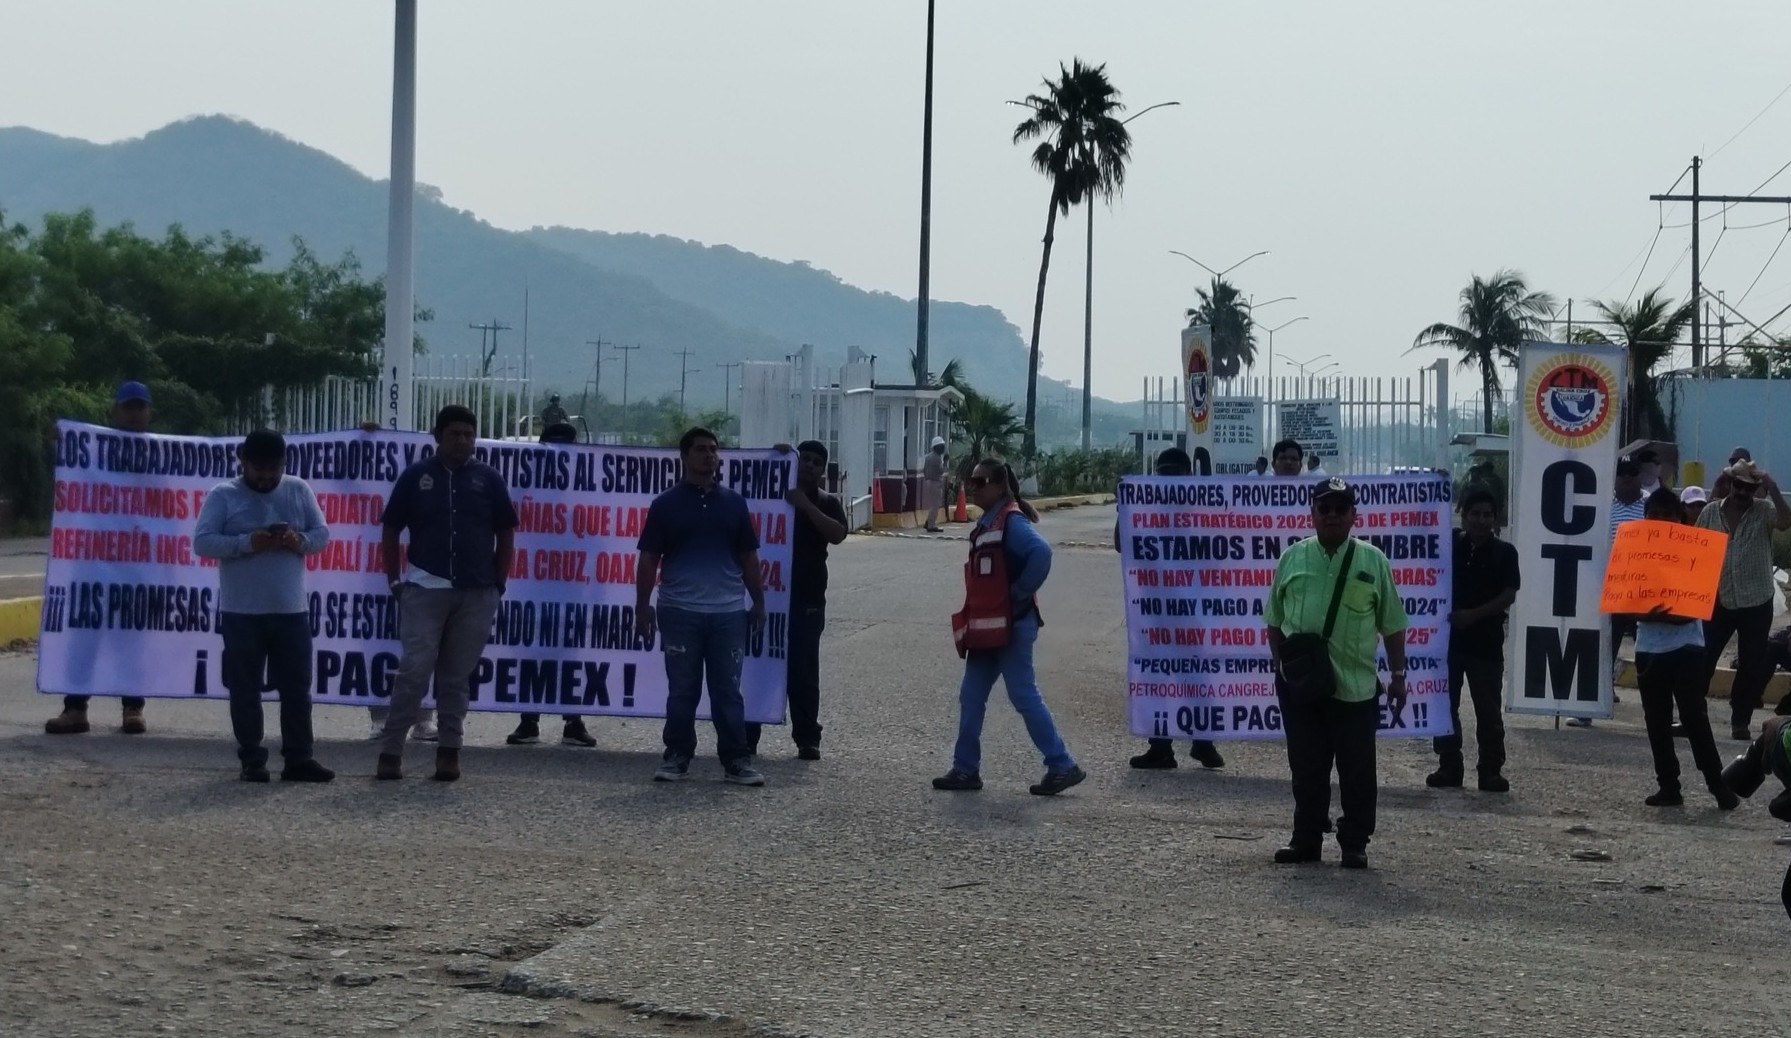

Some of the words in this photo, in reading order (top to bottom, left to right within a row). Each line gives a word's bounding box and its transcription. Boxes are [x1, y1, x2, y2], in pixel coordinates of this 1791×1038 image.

[285, 440, 398, 482] OVEEDORES
[573, 452, 596, 492] AL
[602, 453, 688, 495] SERVICI
[730, 459, 791, 500] PEMEX
[1118, 483, 1229, 510] TRABAJADORES,
[1352, 480, 1451, 507] CONTRATISTAS
[55, 481, 189, 521] SOLICITAMOS
[573, 504, 610, 539] QUE
[766, 513, 787, 545] LA
[1132, 513, 1170, 529] PLAN
[1173, 512, 1273, 529] ESTRATÉGICO
[1368, 513, 1387, 527] DE
[1391, 511, 1440, 527] PEMEX
[1132, 534, 1246, 561] ESTAMOS
[1251, 536, 1281, 560] EN
[1648, 528, 1660, 543] ya
[1668, 525, 1709, 547] basta
[53, 524, 151, 563] REFINERÍA
[156, 534, 194, 567] ING.
[305, 534, 362, 573] OVALÍ
[534, 549, 590, 587] CRUZ,
[1627, 552, 1681, 565] promesas
[1162, 568, 1194, 587] HAY
[1639, 585, 1656, 600] las
[69, 581, 104, 630] LAS
[108, 583, 212, 633] PROMESAS
[326, 591, 348, 639] SE
[540, 602, 560, 648] NI
[564, 603, 587, 648] EN
[1166, 597, 1198, 616] HAY
[1202, 597, 1248, 616] PAGO
[1175, 627, 1207, 646] HAY
[1210, 627, 1256, 647] PAGO
[469, 657, 611, 706] PEMEX
[623, 663, 637, 707] !
[1129, 680, 1215, 699] PETROQUÍMICA
[1416, 679, 1448, 696] CRUZ
[1176, 704, 1225, 735] QUE
